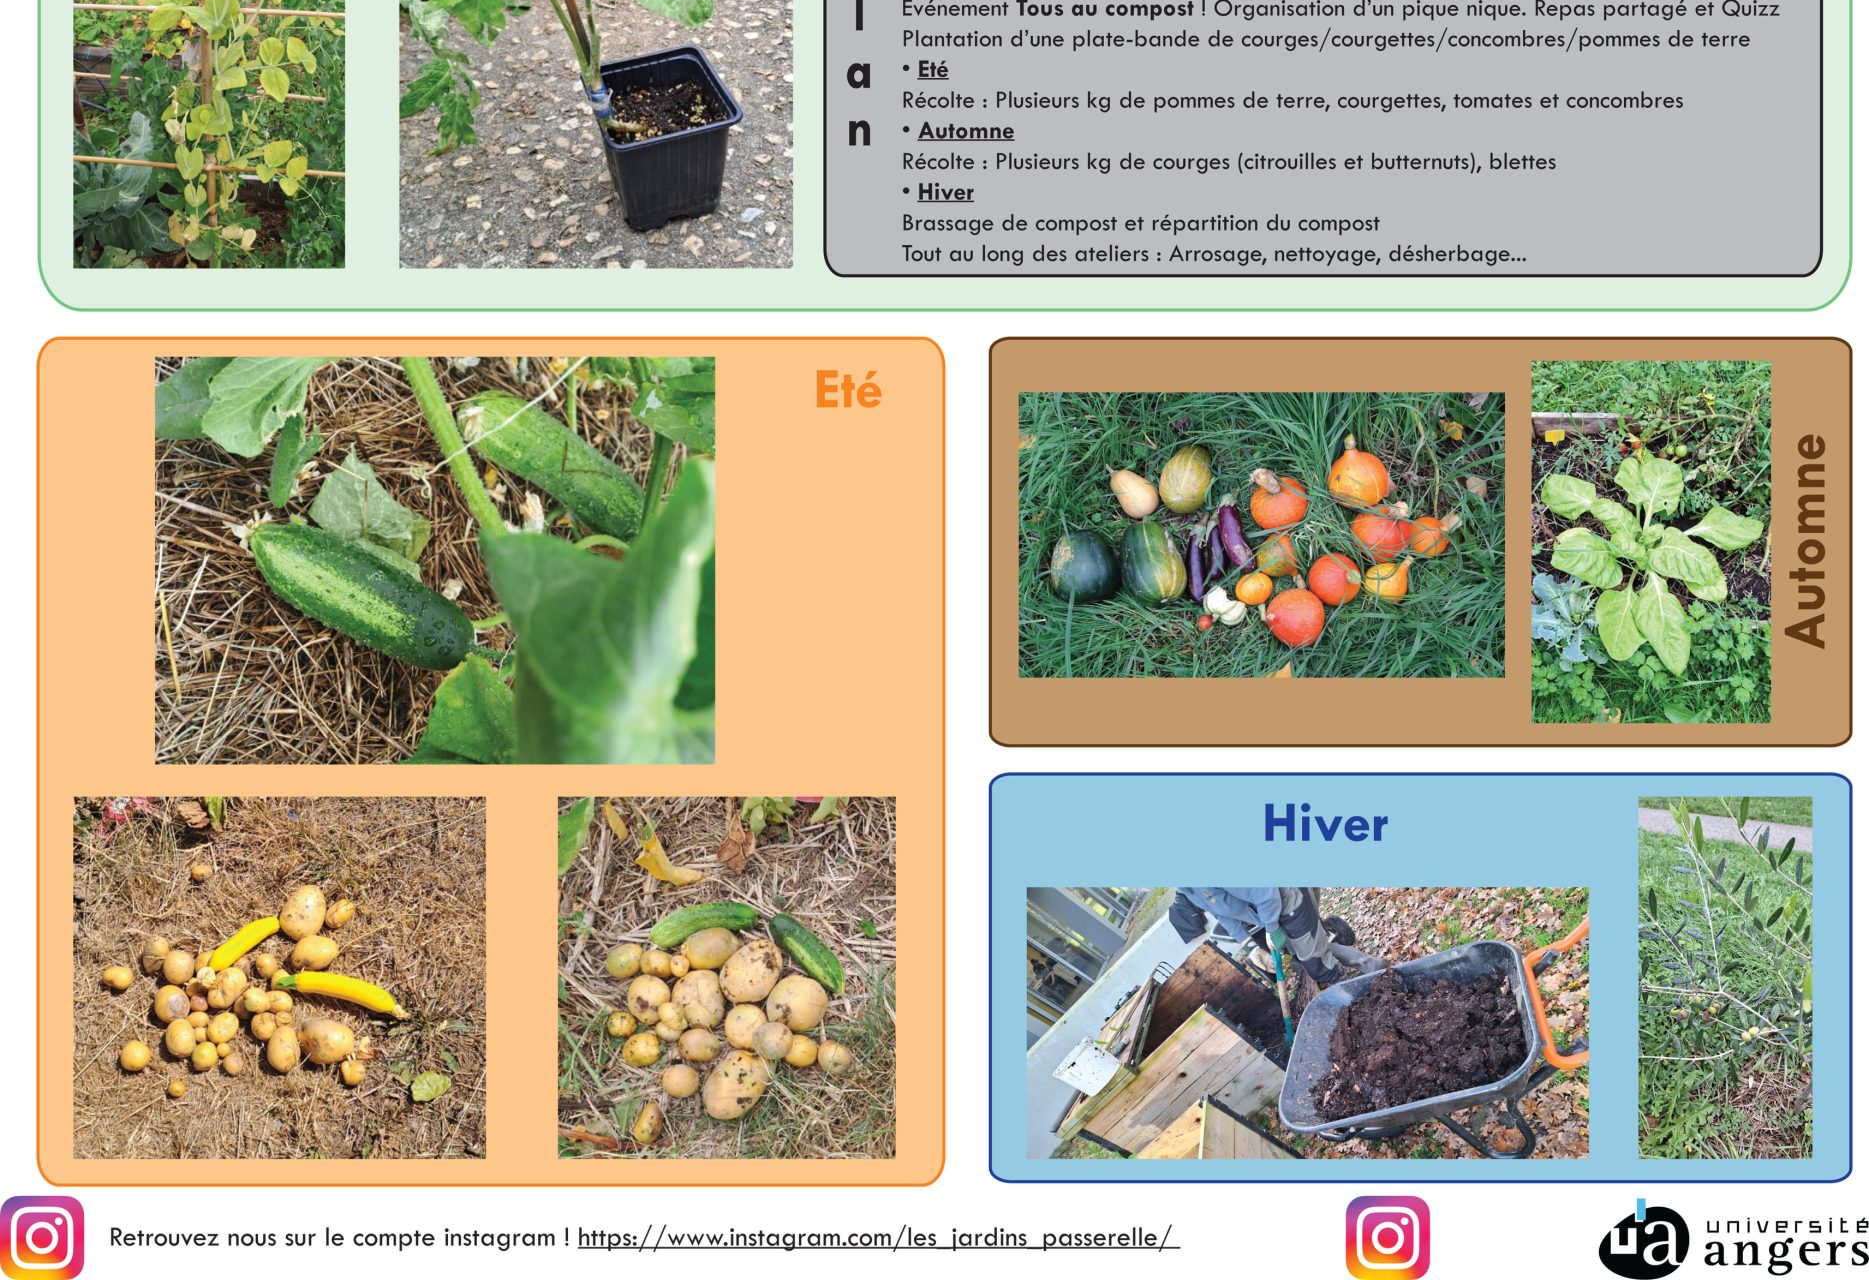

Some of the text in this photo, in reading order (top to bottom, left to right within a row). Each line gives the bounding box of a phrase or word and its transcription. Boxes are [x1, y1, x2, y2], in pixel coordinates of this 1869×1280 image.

[1071, 3, 1098, 17] au
[1105, 0, 1195, 21] compost
[1402, 0, 1459, 22] pique
[1466, 0, 1527, 22] nique.
[1603, 0, 1688, 22] partagé
[1694, 1, 1715, 17] et
[903, 26, 1751, 53] Plantation d’une plate-bande de courges/courgettes/concombres/pommes de terre
[916, 59, 950, 81] Eté
[902, 90, 975, 109] Récolte
[996, 90, 1080, 109] Plusieurs
[1087, 90, 1111, 113] kg
[1119, 90, 1146, 109] de
[1153, 96, 1236, 113] pommes
[1242, 90, 1269, 109] de
[1276, 93, 1331, 113] terre,
[1337, 93, 1447, 114] courgettes,
[1453, 93, 1533, 109] tomates
[1539, 93, 1560, 109] et
[1566, 90, 1684, 109] concombres
[917, 121, 1016, 142] Automne
[902, 152, 975, 170] Récolte
[996, 152, 1080, 170] Plusieurs
[1087, 152, 1111, 175] kg
[1119, 152, 1146, 170] de
[1152, 157, 1230, 175] courges
[1237, 151, 1337, 175] (citrouilles
[1343, 154, 1364, 170] et
[1371, 152, 1482, 175] butternuts),
[1489, 152, 1557, 170] blettes
[916, 182, 975, 203] Hiver
[902, 213, 1381, 236] Brassage de compost et répartition du compost
[901, 244, 942, 262] Tout
[949, 249, 974, 262] au
[982, 244, 1024, 267] long
[1032, 244, 1068, 262] des
[1074, 244, 1149, 263] ateliers
[1168, 244, 1268, 267] Arrosage,
[1274, 247, 1382, 267] nettoyage,
[1388, 244, 1527, 267] désherbage...
[816, 369, 882, 409] Eté
[1784, 434, 1826, 650] Automne
[1264, 802, 1389, 842] Hiver
[1706, 1216, 1869, 1234] université
[110, 1226, 220, 1247] Retrouvez
[227, 1232, 277, 1247] nous
[284, 1232, 317, 1247] sur
[325, 1226, 345, 1247] le
[352, 1229, 436, 1252] compte
[444, 1227, 556, 1252] instagram
[578, 1223, 1173, 1253] https://www.instagram.com/les_jardins_passerelle/
[1703, 1237, 1869, 1277] angers
